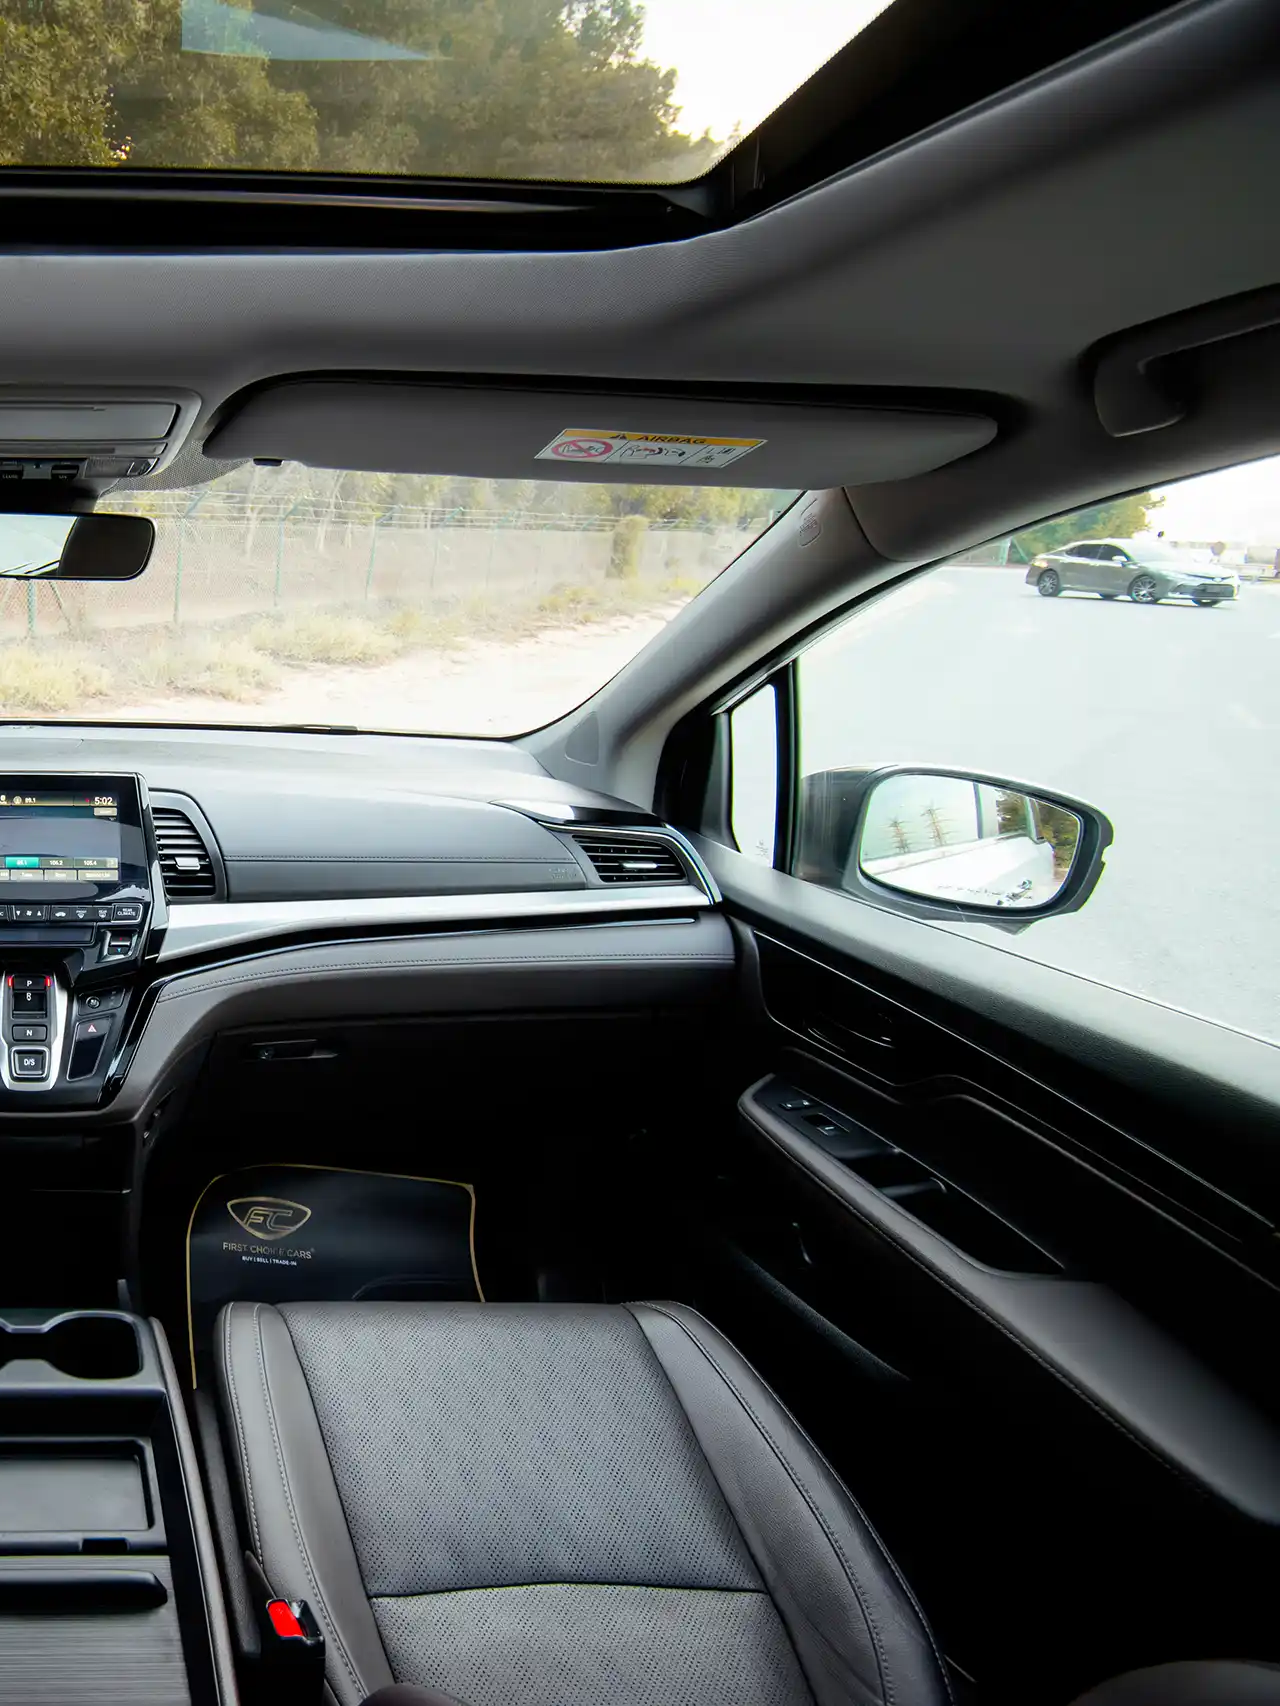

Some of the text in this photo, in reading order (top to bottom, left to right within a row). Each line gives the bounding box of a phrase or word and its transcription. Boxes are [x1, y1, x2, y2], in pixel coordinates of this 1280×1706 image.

[93, 796, 113, 806] 5:02
[26, 979, 33, 987] P
[26, 1029, 33, 1037] N
[23, 1058, 36, 1067] D/S
[222, 1241, 248, 1252] FIRST
[287, 1249, 312, 1260] CARS
[272, 1258, 297, 1266] TRADE-IN
